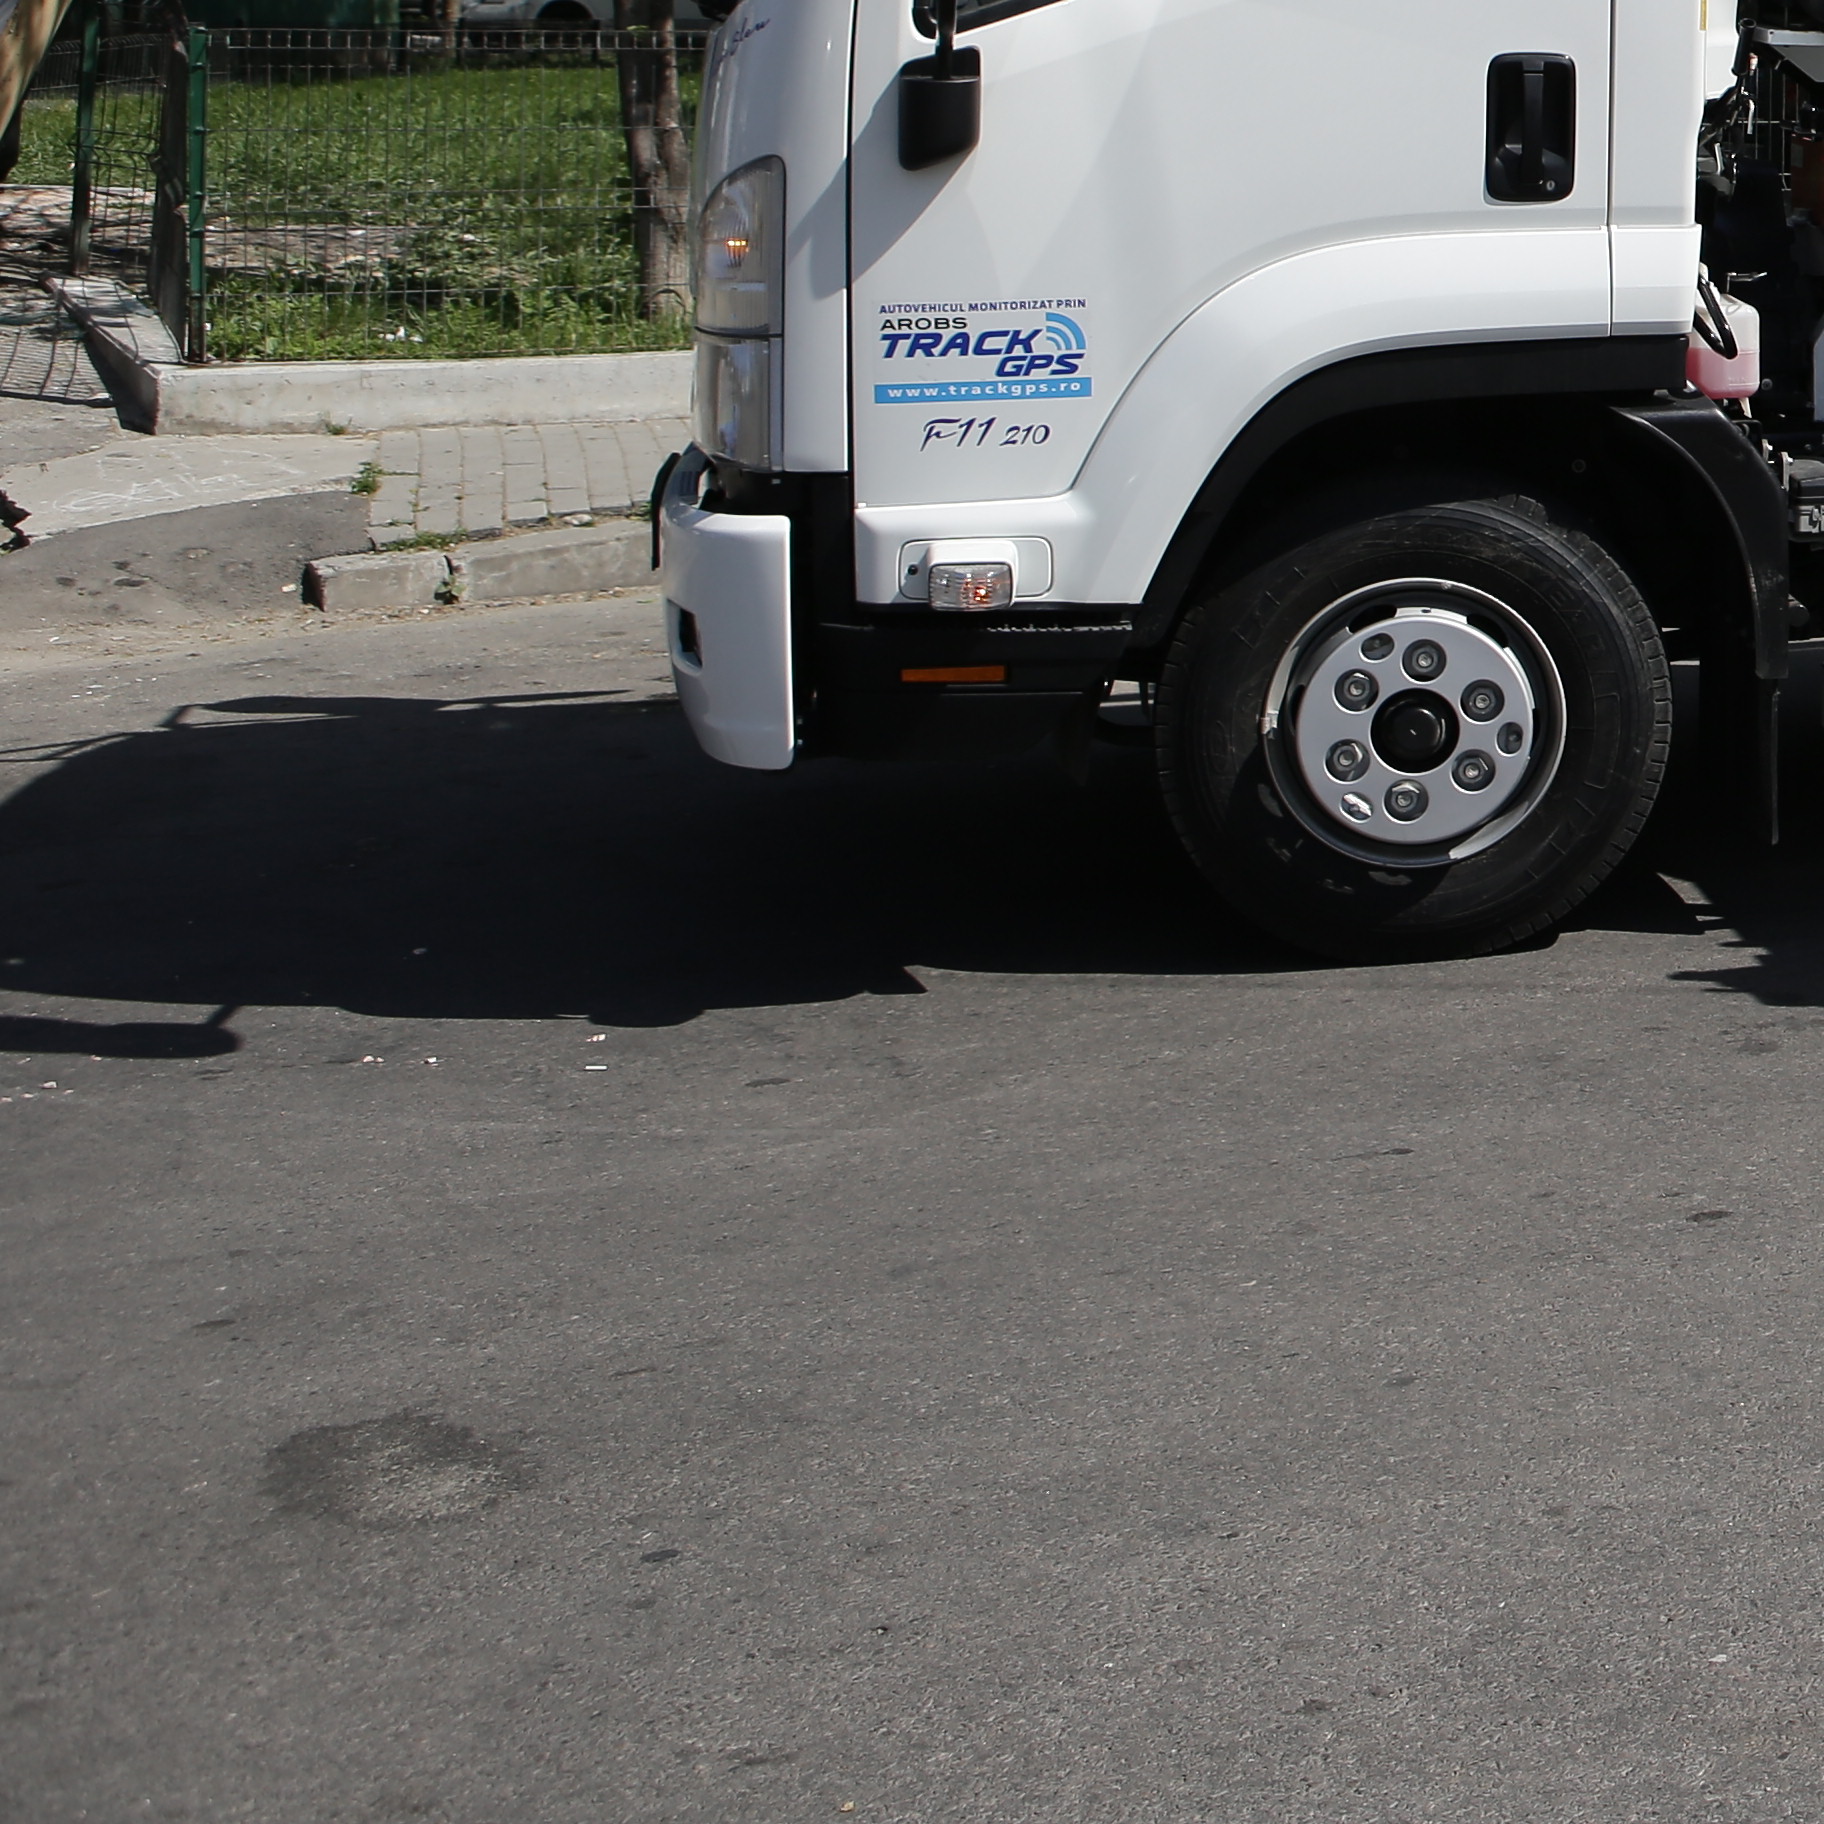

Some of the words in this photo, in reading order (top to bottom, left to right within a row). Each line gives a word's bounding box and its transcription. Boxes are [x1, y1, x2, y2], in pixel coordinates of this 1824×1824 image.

[879, 303, 965, 314] AUTOVEHICUL
[968, 300, 1054, 312] MONITORIZAT
[1057, 298, 1087, 308] PRIN
[880, 317, 968, 331] AROBS
[880, 329, 1043, 359] TRACK
[995, 353, 1085, 377] GPS
[887, 382, 1081, 398] www.trackgps.ro
[920, 417, 997, 452] F11
[1000, 425, 1051, 447] 210
